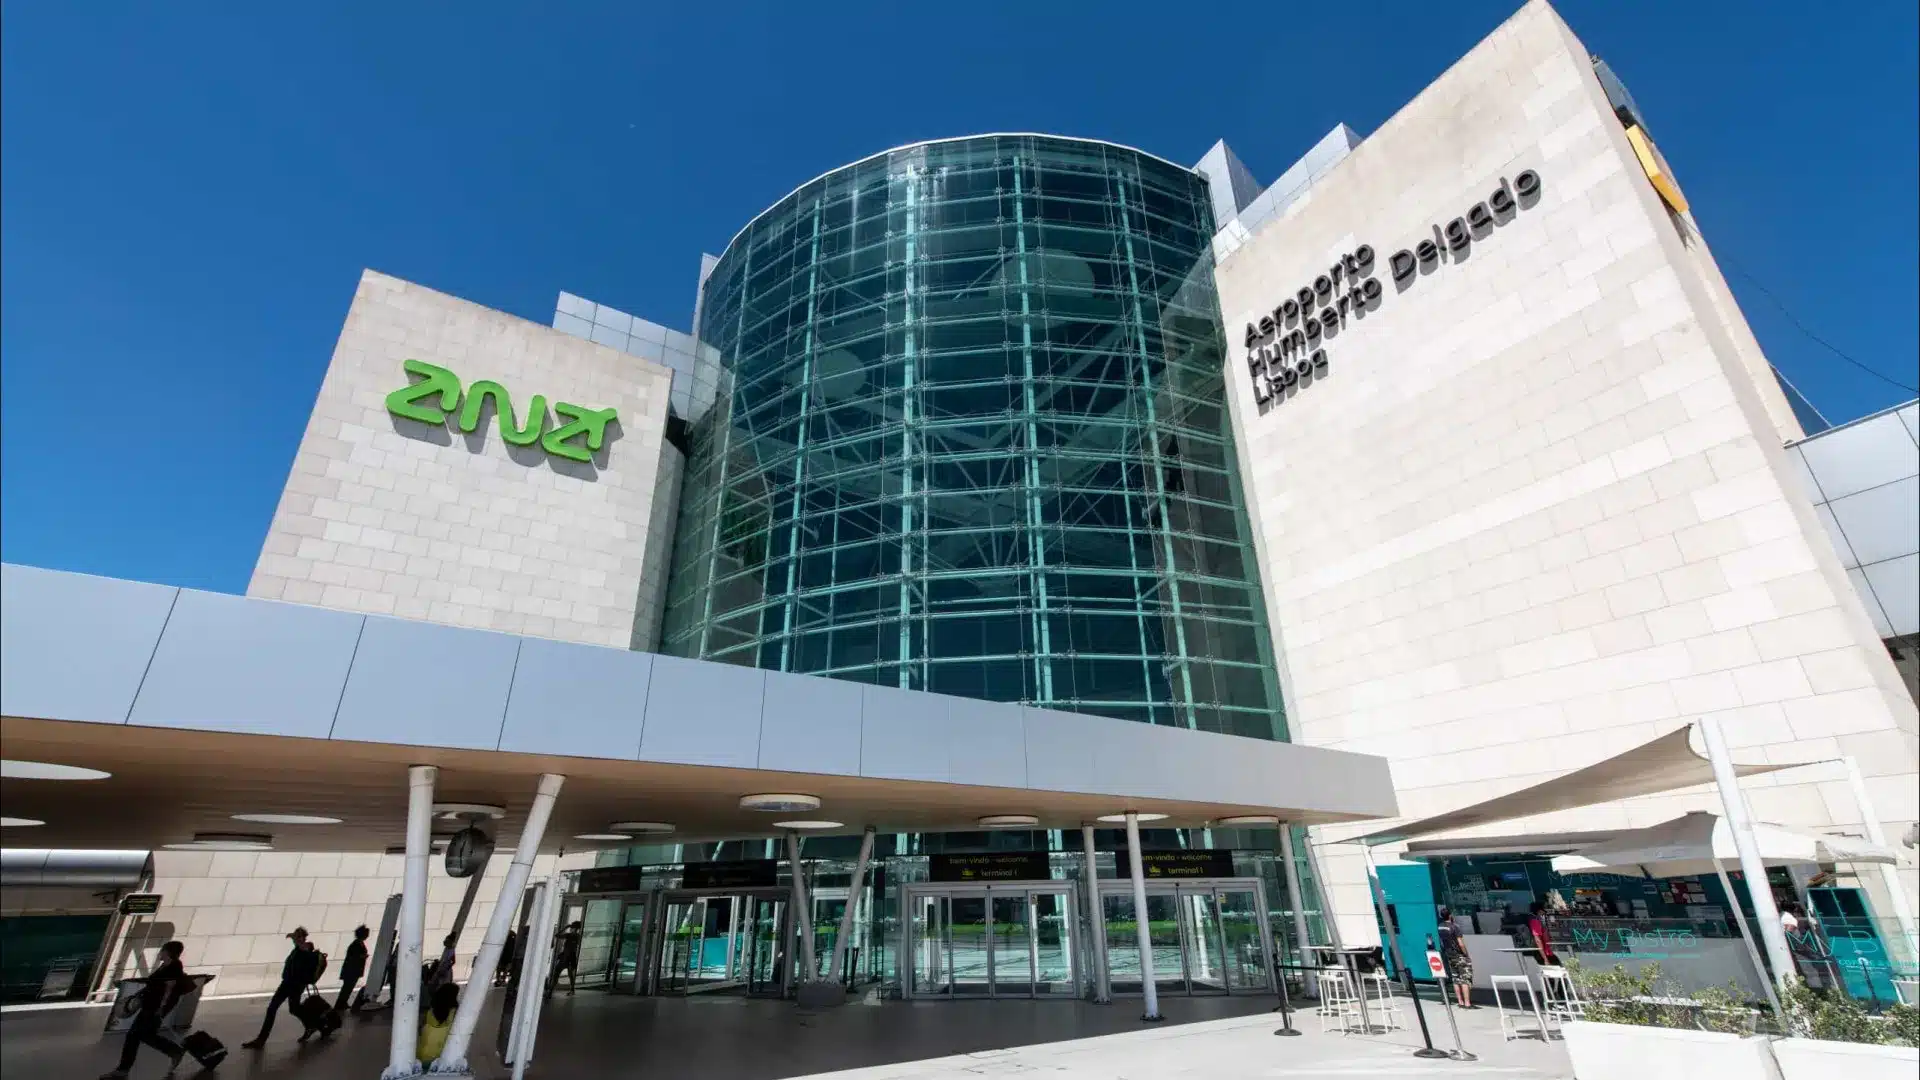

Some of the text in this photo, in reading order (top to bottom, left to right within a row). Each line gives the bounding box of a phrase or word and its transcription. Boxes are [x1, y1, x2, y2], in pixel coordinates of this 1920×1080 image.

[1245, 244, 1375, 347] Aeroporto
[1248, 169, 1541, 377] Humberto Delgado
[1253, 348, 1329, 416] Lisboa
[981, 868, 1012, 877] terminal
[1168, 866, 1198, 875] terminal
[1573, 928, 1609, 951] My
